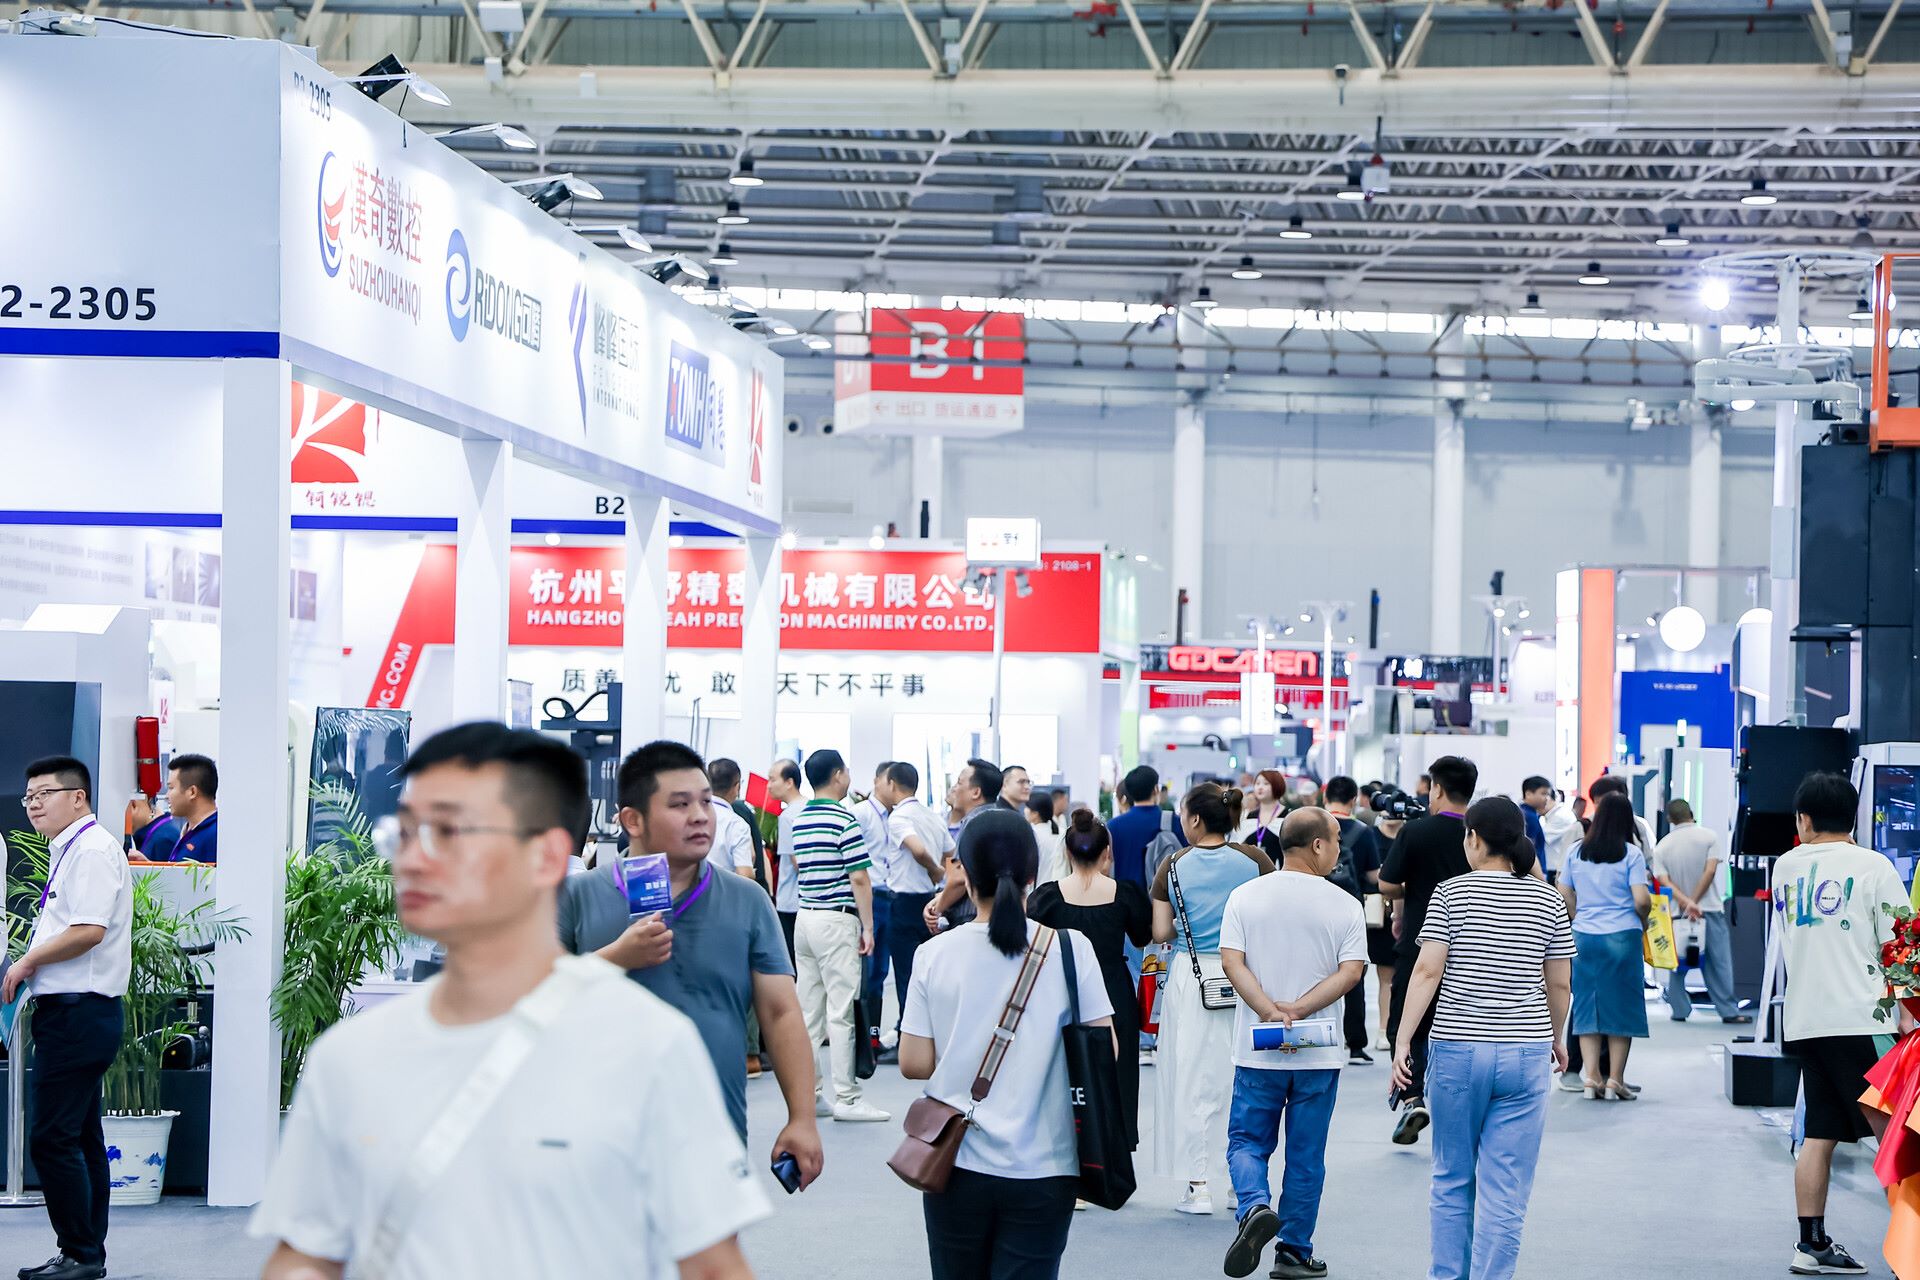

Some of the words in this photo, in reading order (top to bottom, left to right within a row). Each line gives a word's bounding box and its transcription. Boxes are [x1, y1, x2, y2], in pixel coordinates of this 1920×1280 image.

[349, 253, 422, 326] SUZHOUHANQI
[910, 321, 984, 381] B1
[670, 357, 707, 443] TONH
[527, 610, 625, 626] HANGZHO
[807, 613, 919, 630] MACHINERY
[921, 614, 994, 631] CO.LTD.
[562, 668, 681, 693] 质善优
[712, 671, 926, 697] 敢天下不平事
